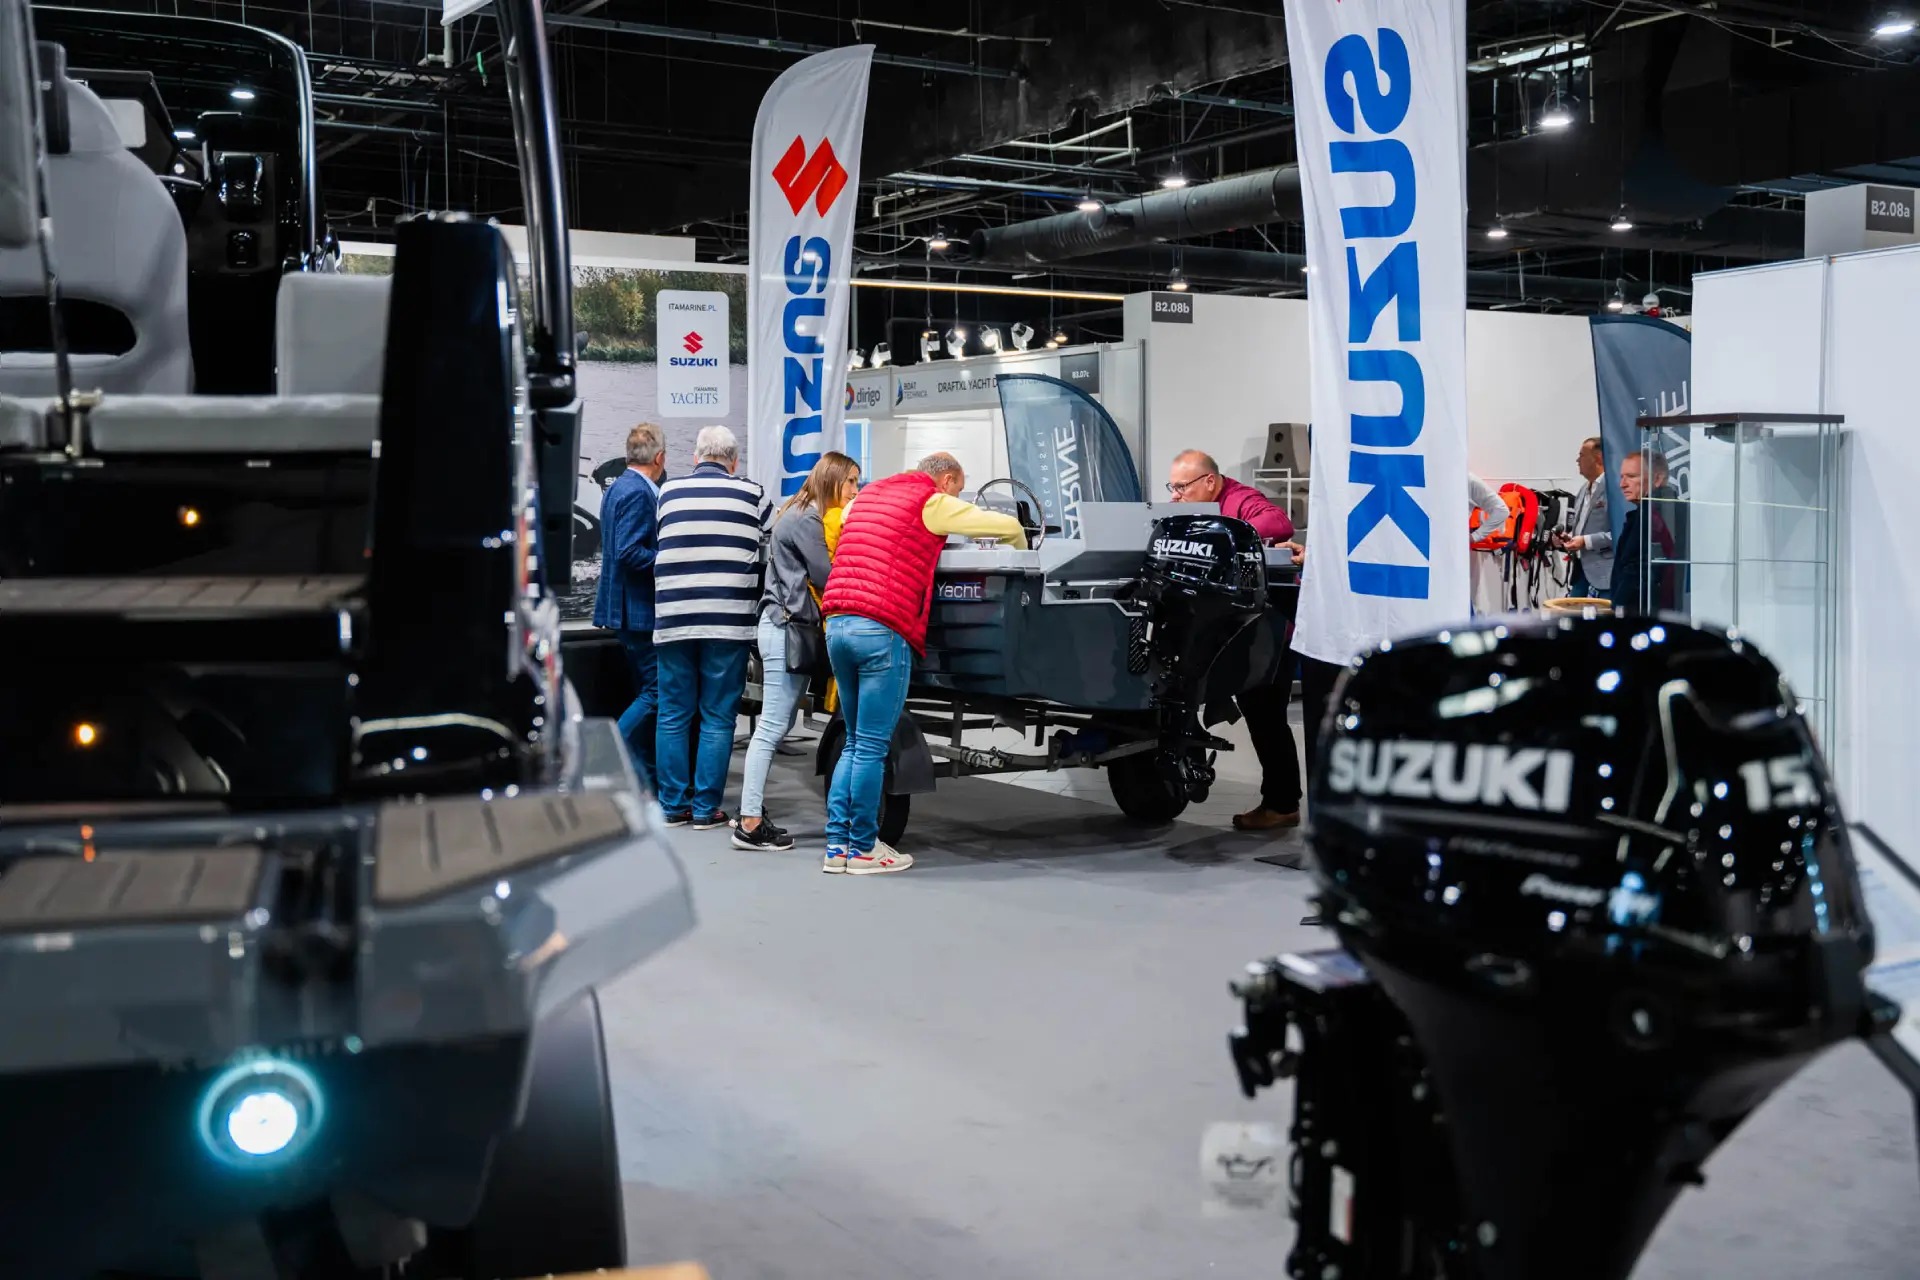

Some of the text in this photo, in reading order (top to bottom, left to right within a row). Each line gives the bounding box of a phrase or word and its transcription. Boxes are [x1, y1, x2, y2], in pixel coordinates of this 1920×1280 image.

[1871, 200, 1910, 218] B2.08a
[668, 303, 717, 312] ITAMARINE.PL
[1155, 301, 1190, 313] B2.08b
[669, 357, 718, 367] SUZUKI
[781, 235, 831, 497] SUZU
[968, 378, 991, 390] YACHT
[670, 392, 718, 404] YACHTS
[856, 387, 881, 407] dirigo
[1152, 539, 1214, 558] SUZUKI
[937, 581, 982, 599] Yacht
[1329, 738, 1574, 814] SUZUKI
[1737, 754, 1817, 813] 15
